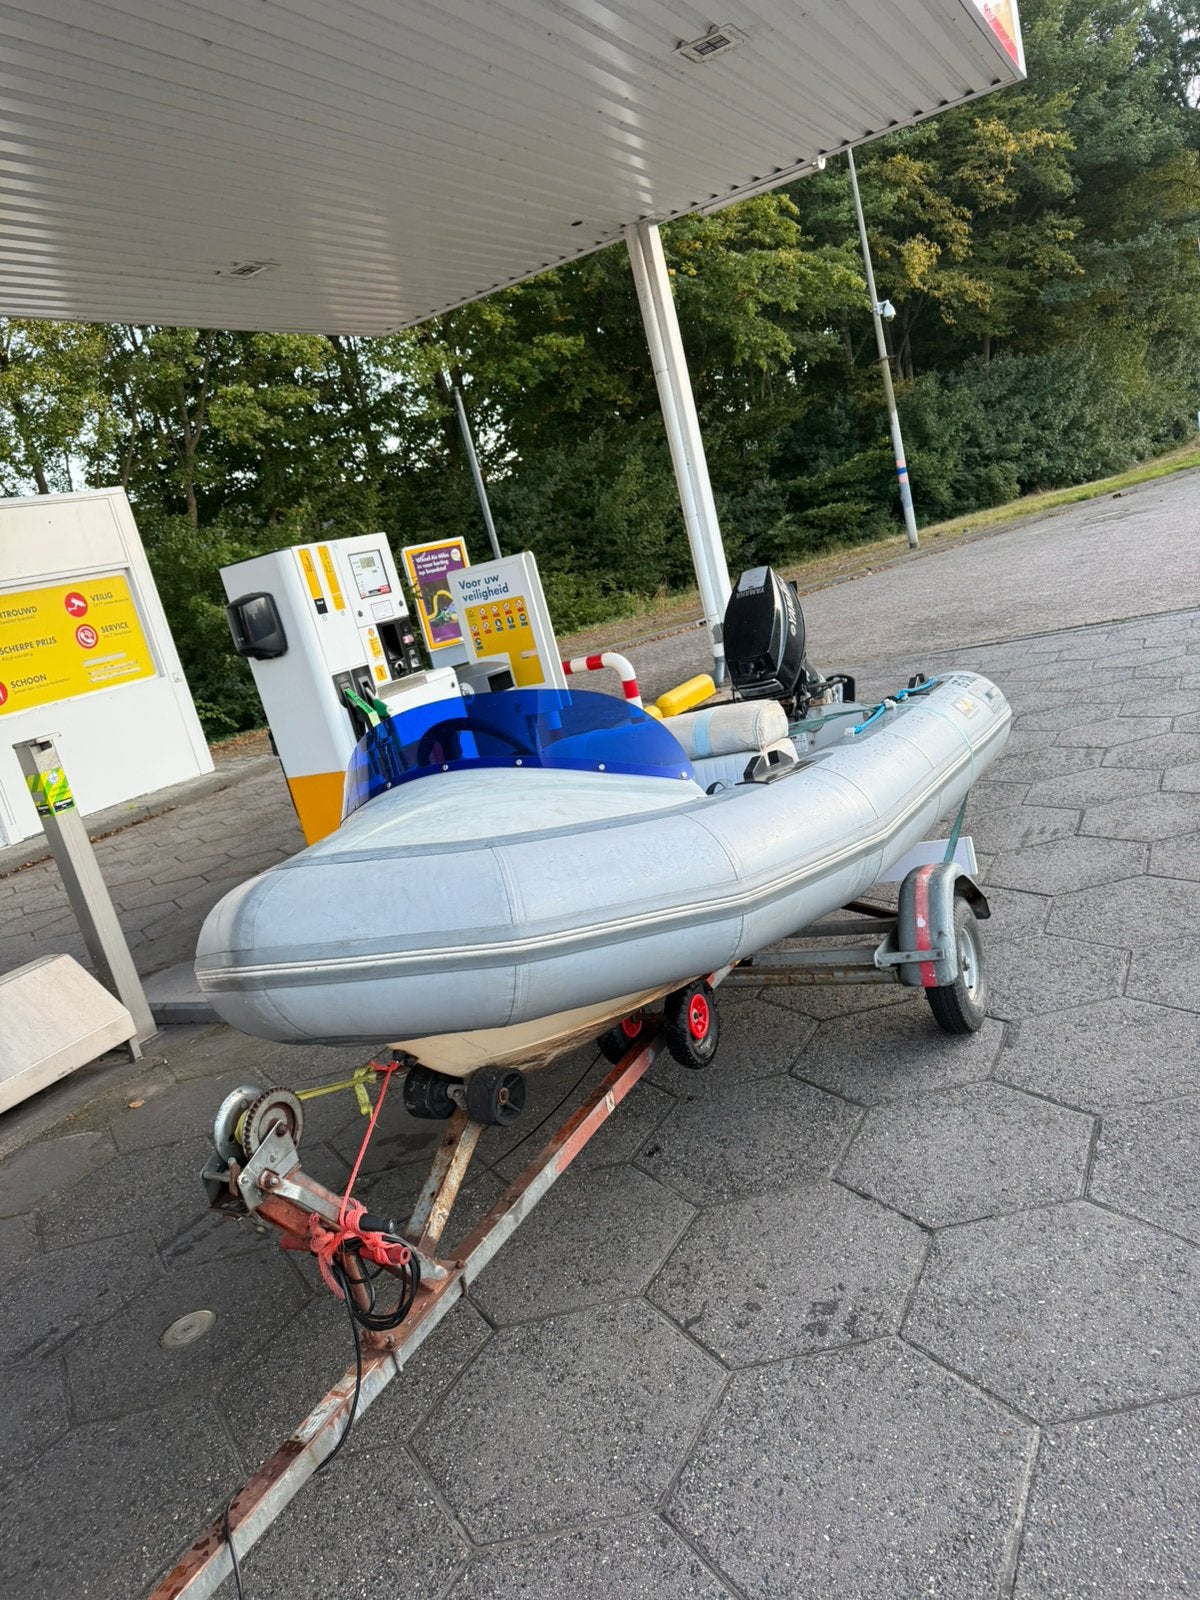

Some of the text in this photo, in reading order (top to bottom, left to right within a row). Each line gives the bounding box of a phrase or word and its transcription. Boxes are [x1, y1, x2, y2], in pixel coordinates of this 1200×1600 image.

[458, 574, 500, 590] Voor uw
[90, 591, 114, 603] VEILIG
[462, 582, 510, 602] veiligheid
[100, 621, 129, 634] SERVICE
[0, 636, 58, 656] SCHERPE PRIJS
[10, 673, 48, 689] SCHOON
